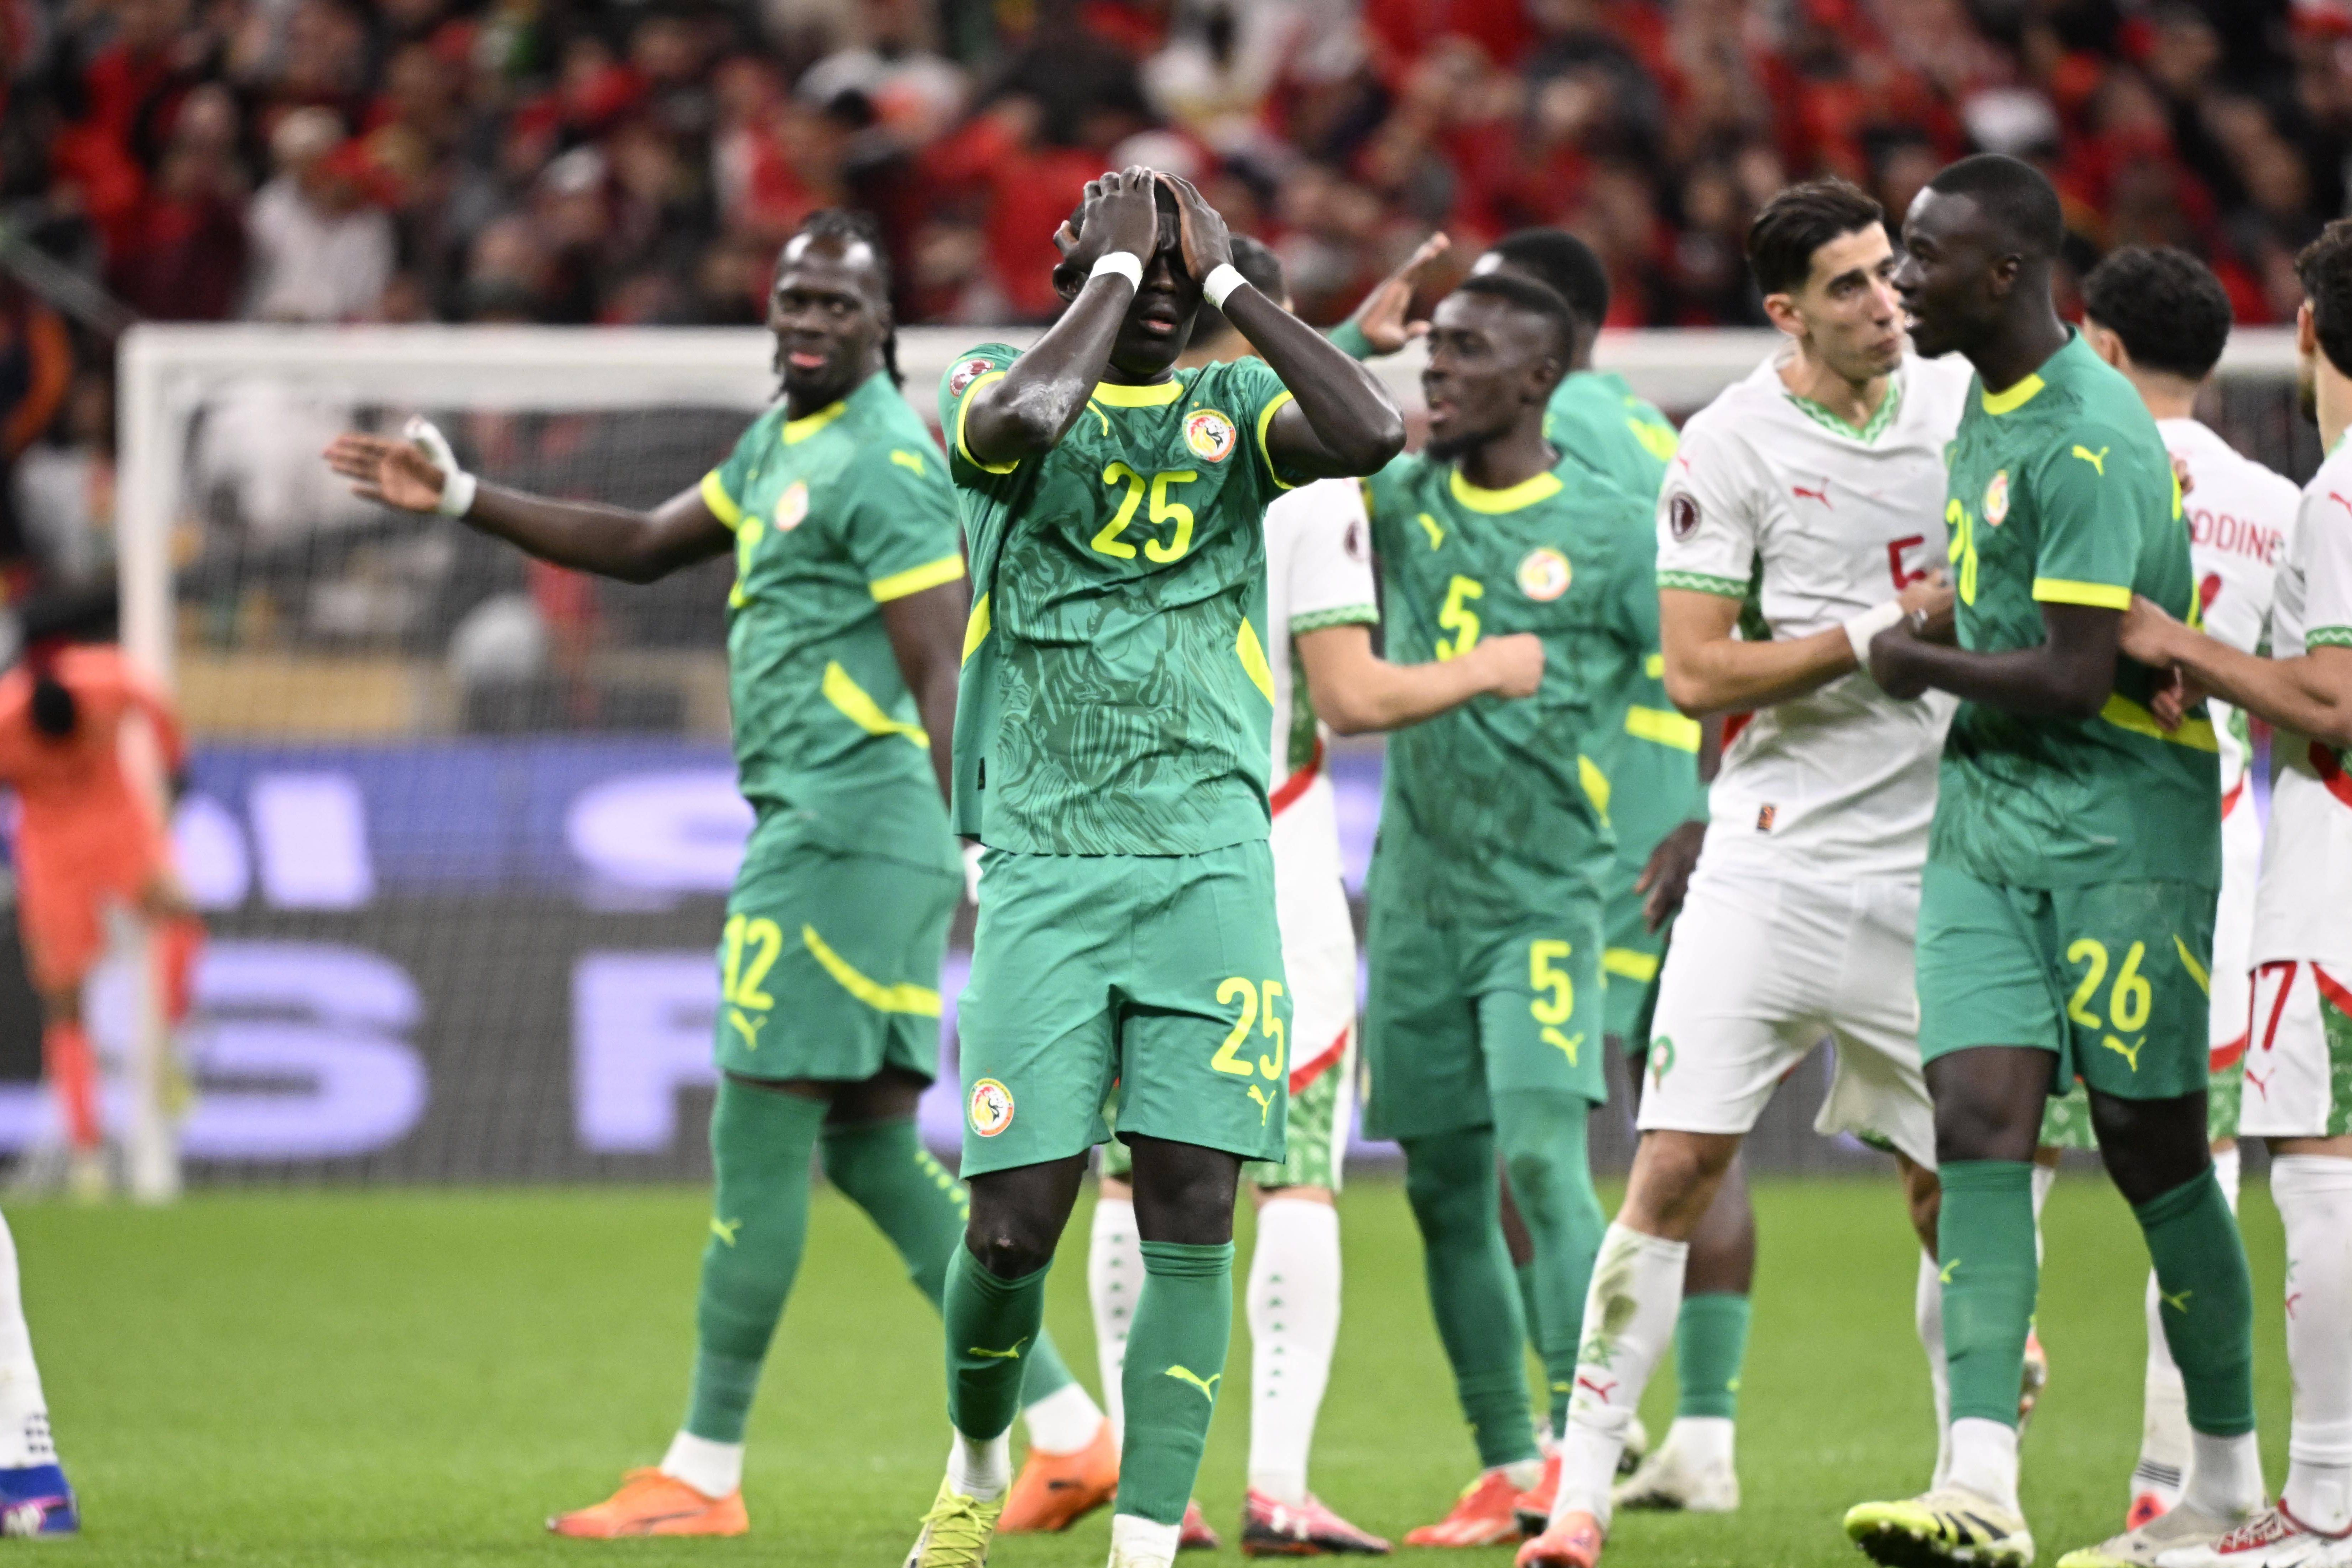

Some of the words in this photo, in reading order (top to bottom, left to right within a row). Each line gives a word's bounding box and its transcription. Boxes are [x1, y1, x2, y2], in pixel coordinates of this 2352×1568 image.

[1091, 462, 1197, 563] 25
[1436, 575, 1484, 662] 5
[724, 913, 782, 1011] 12
[1530, 939, 1573, 1024] 5
[2067, 938, 2152, 1032] 26
[2246, 960, 2298, 1052] 17
[1211, 977, 1284, 1080] 25
